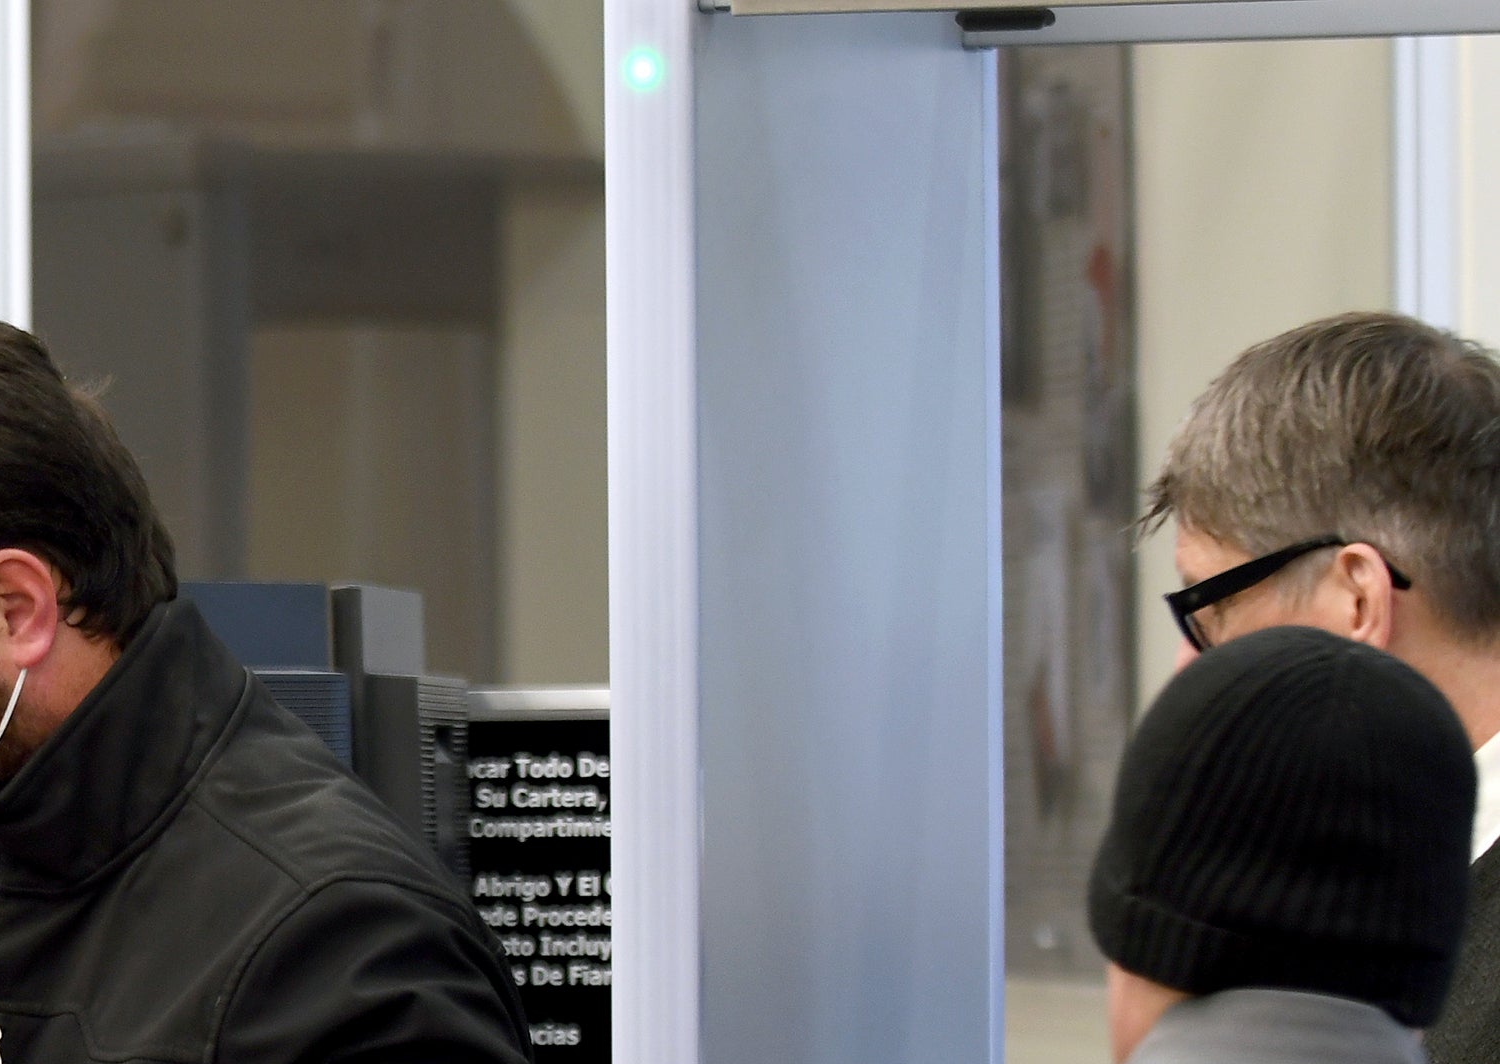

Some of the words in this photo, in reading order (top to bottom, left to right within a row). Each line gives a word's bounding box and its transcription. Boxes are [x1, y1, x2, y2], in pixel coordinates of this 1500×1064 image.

[514, 757, 573, 779] Todo
[476, 787, 506, 808] Su
[512, 786, 607, 813] Cartera,
[475, 876, 551, 902] Abrigo
[555, 876, 573, 897] Y
[578, 875, 601, 897] El
[531, 965, 564, 987] De
